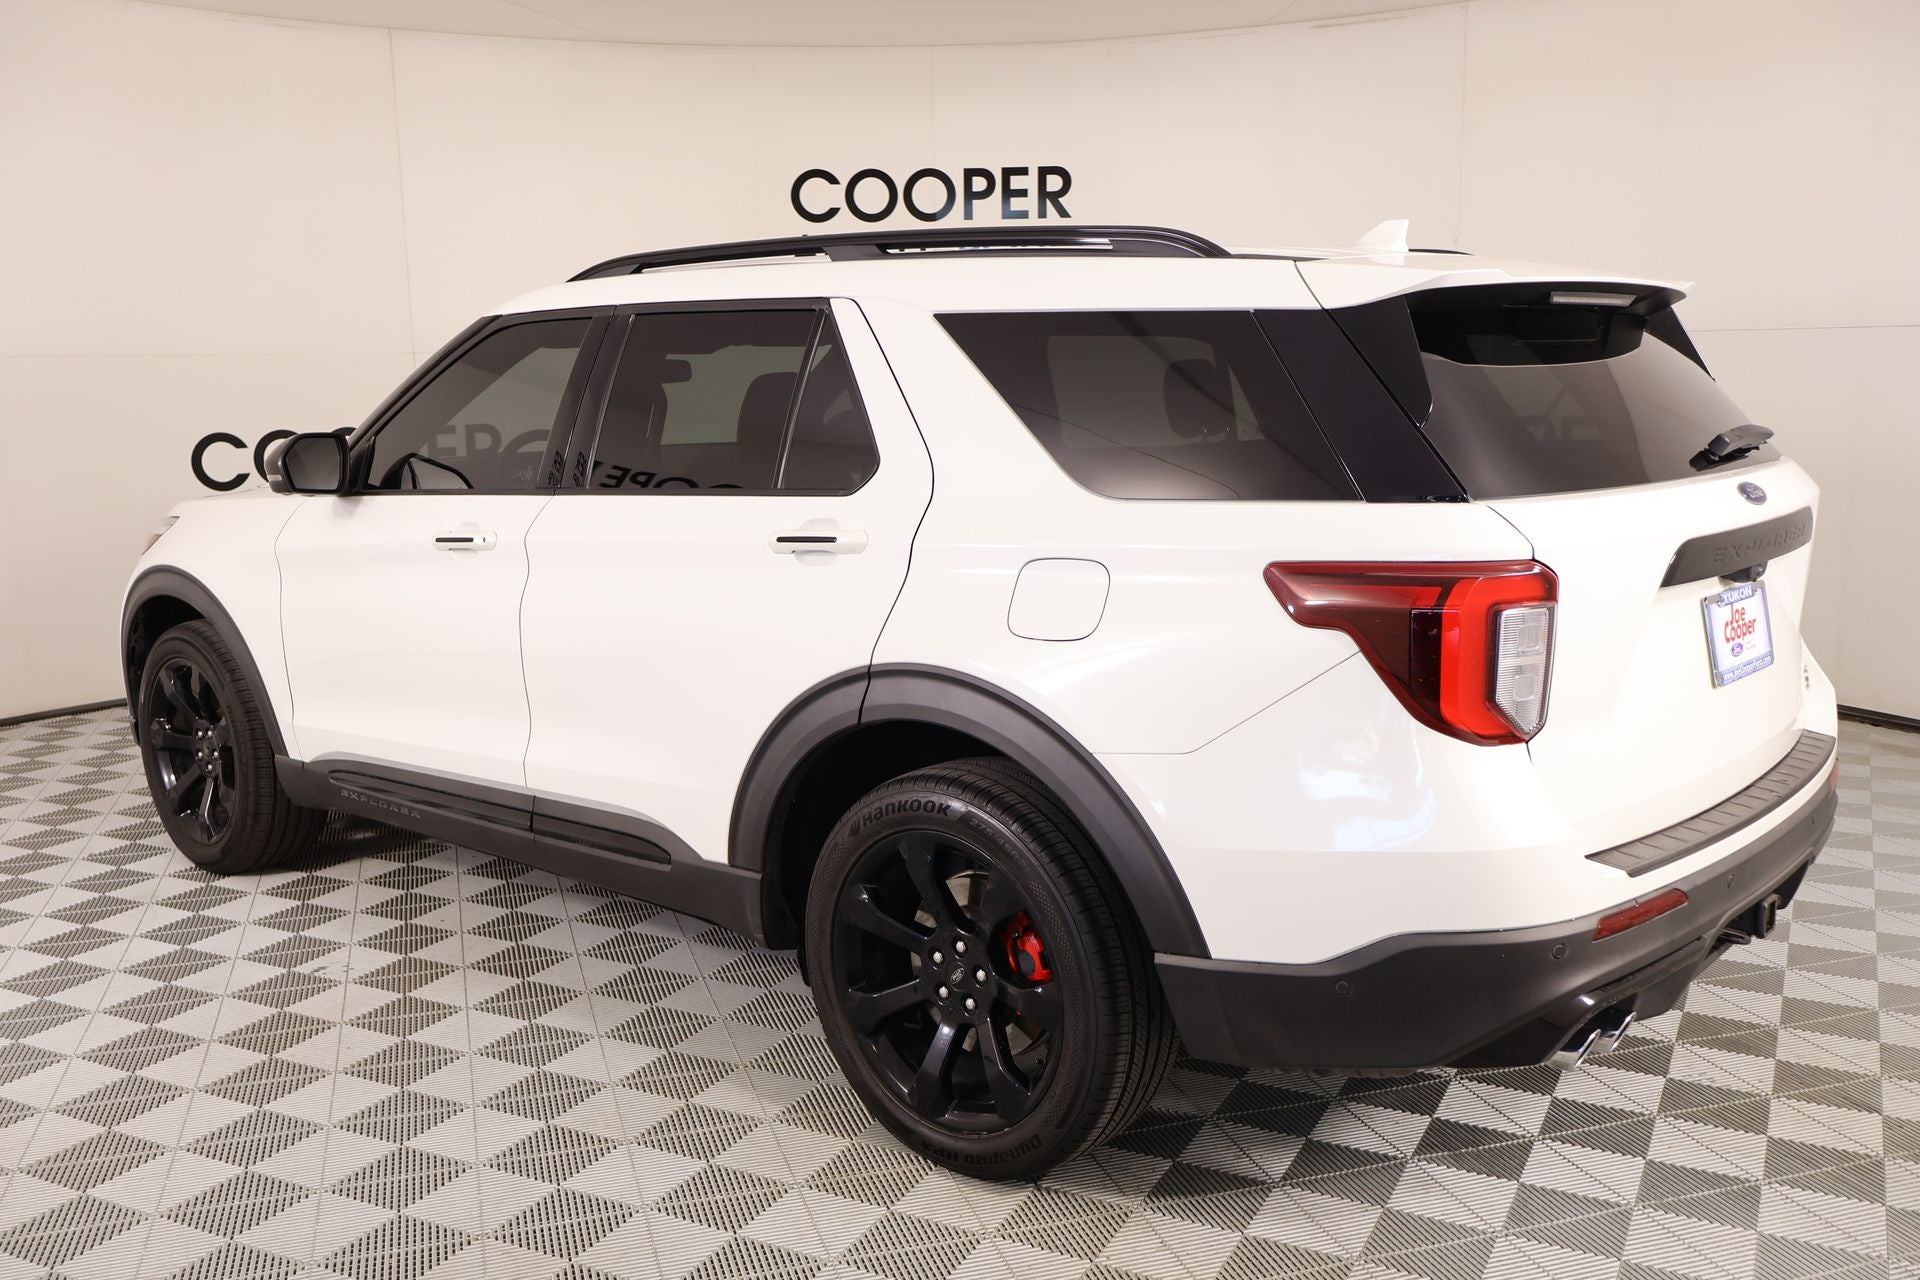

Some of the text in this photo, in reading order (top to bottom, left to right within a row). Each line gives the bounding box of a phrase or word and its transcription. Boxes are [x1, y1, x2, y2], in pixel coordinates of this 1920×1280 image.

[790, 166, 1072, 223] COOPER
[1722, 585, 1753, 603] YUKON
[1730, 603, 1746, 626] Joe
[1724, 617, 1757, 644] Cooper
